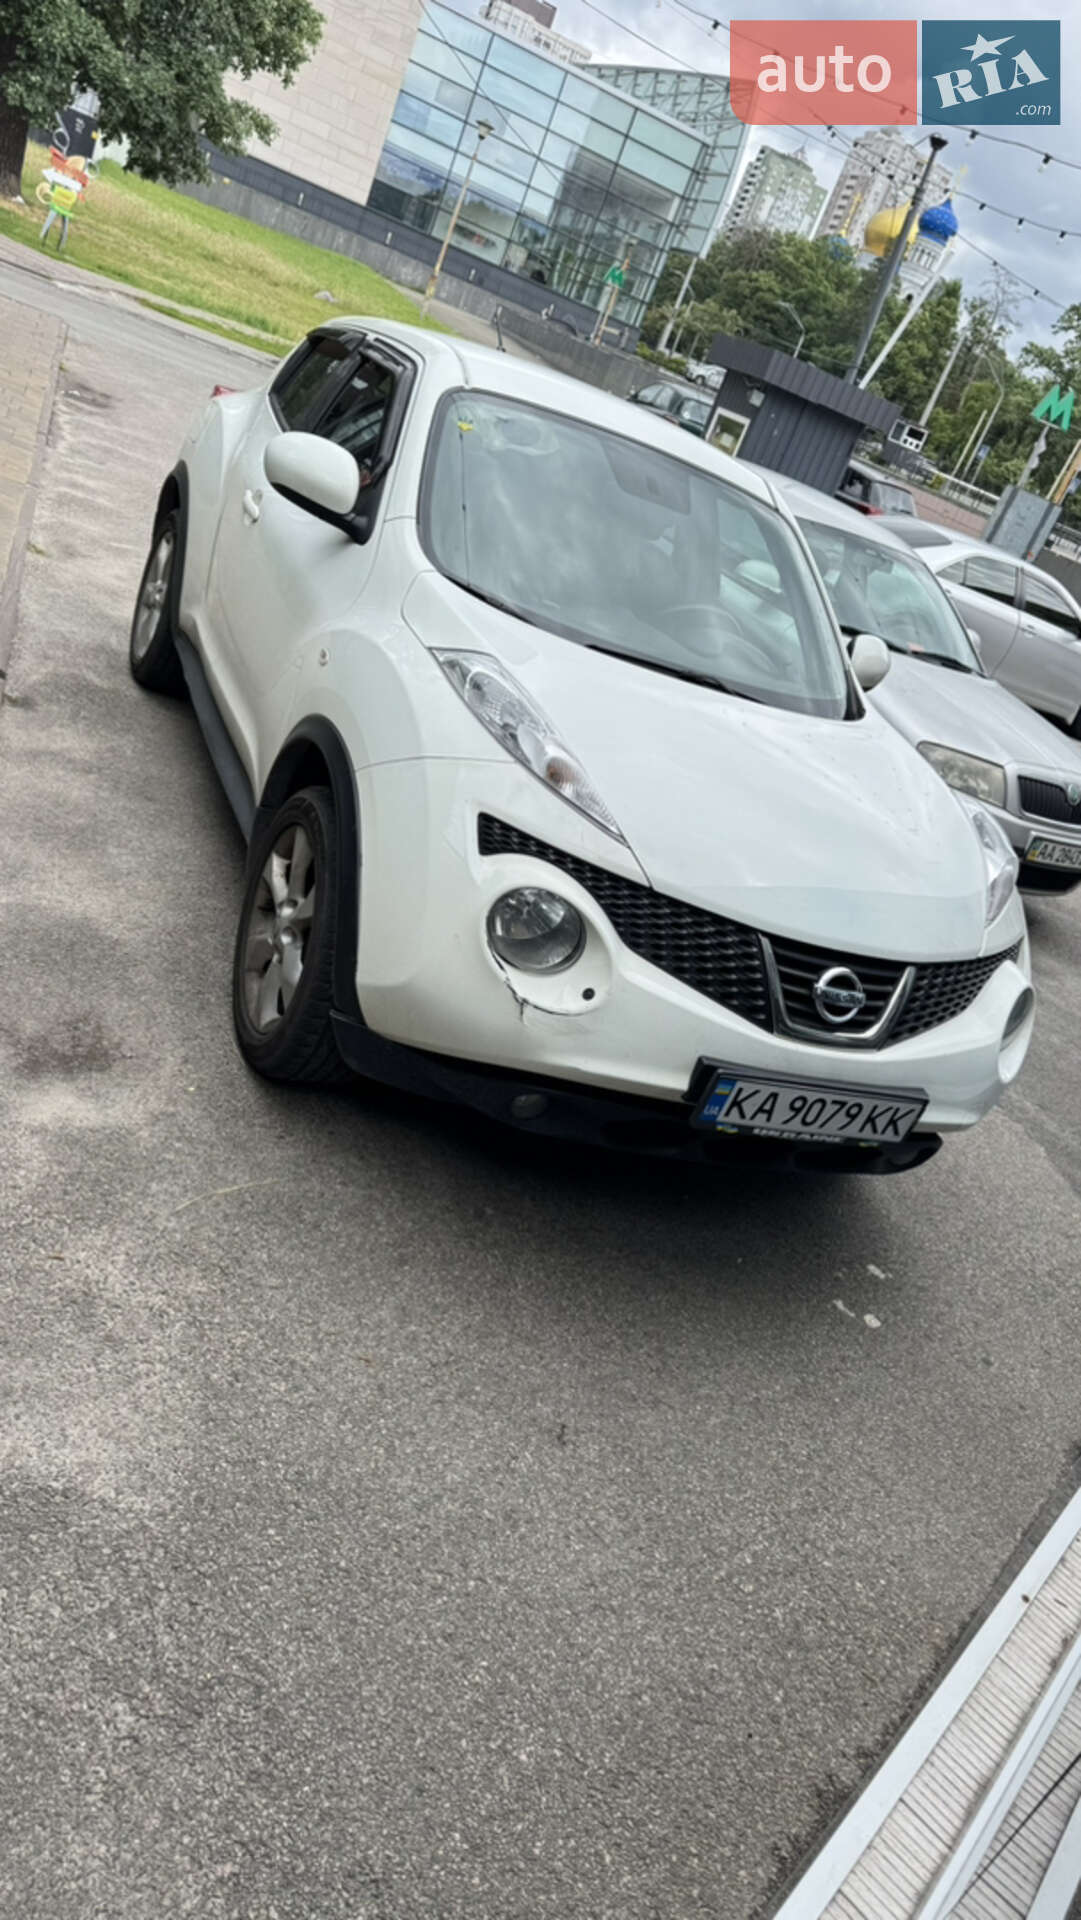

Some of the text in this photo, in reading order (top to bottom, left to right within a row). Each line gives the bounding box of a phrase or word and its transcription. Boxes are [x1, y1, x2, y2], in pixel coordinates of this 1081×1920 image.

[723, 1086, 779, 1123] KA
[781, 1095, 863, 1132] 9079
[858, 1105, 915, 1137] KK
